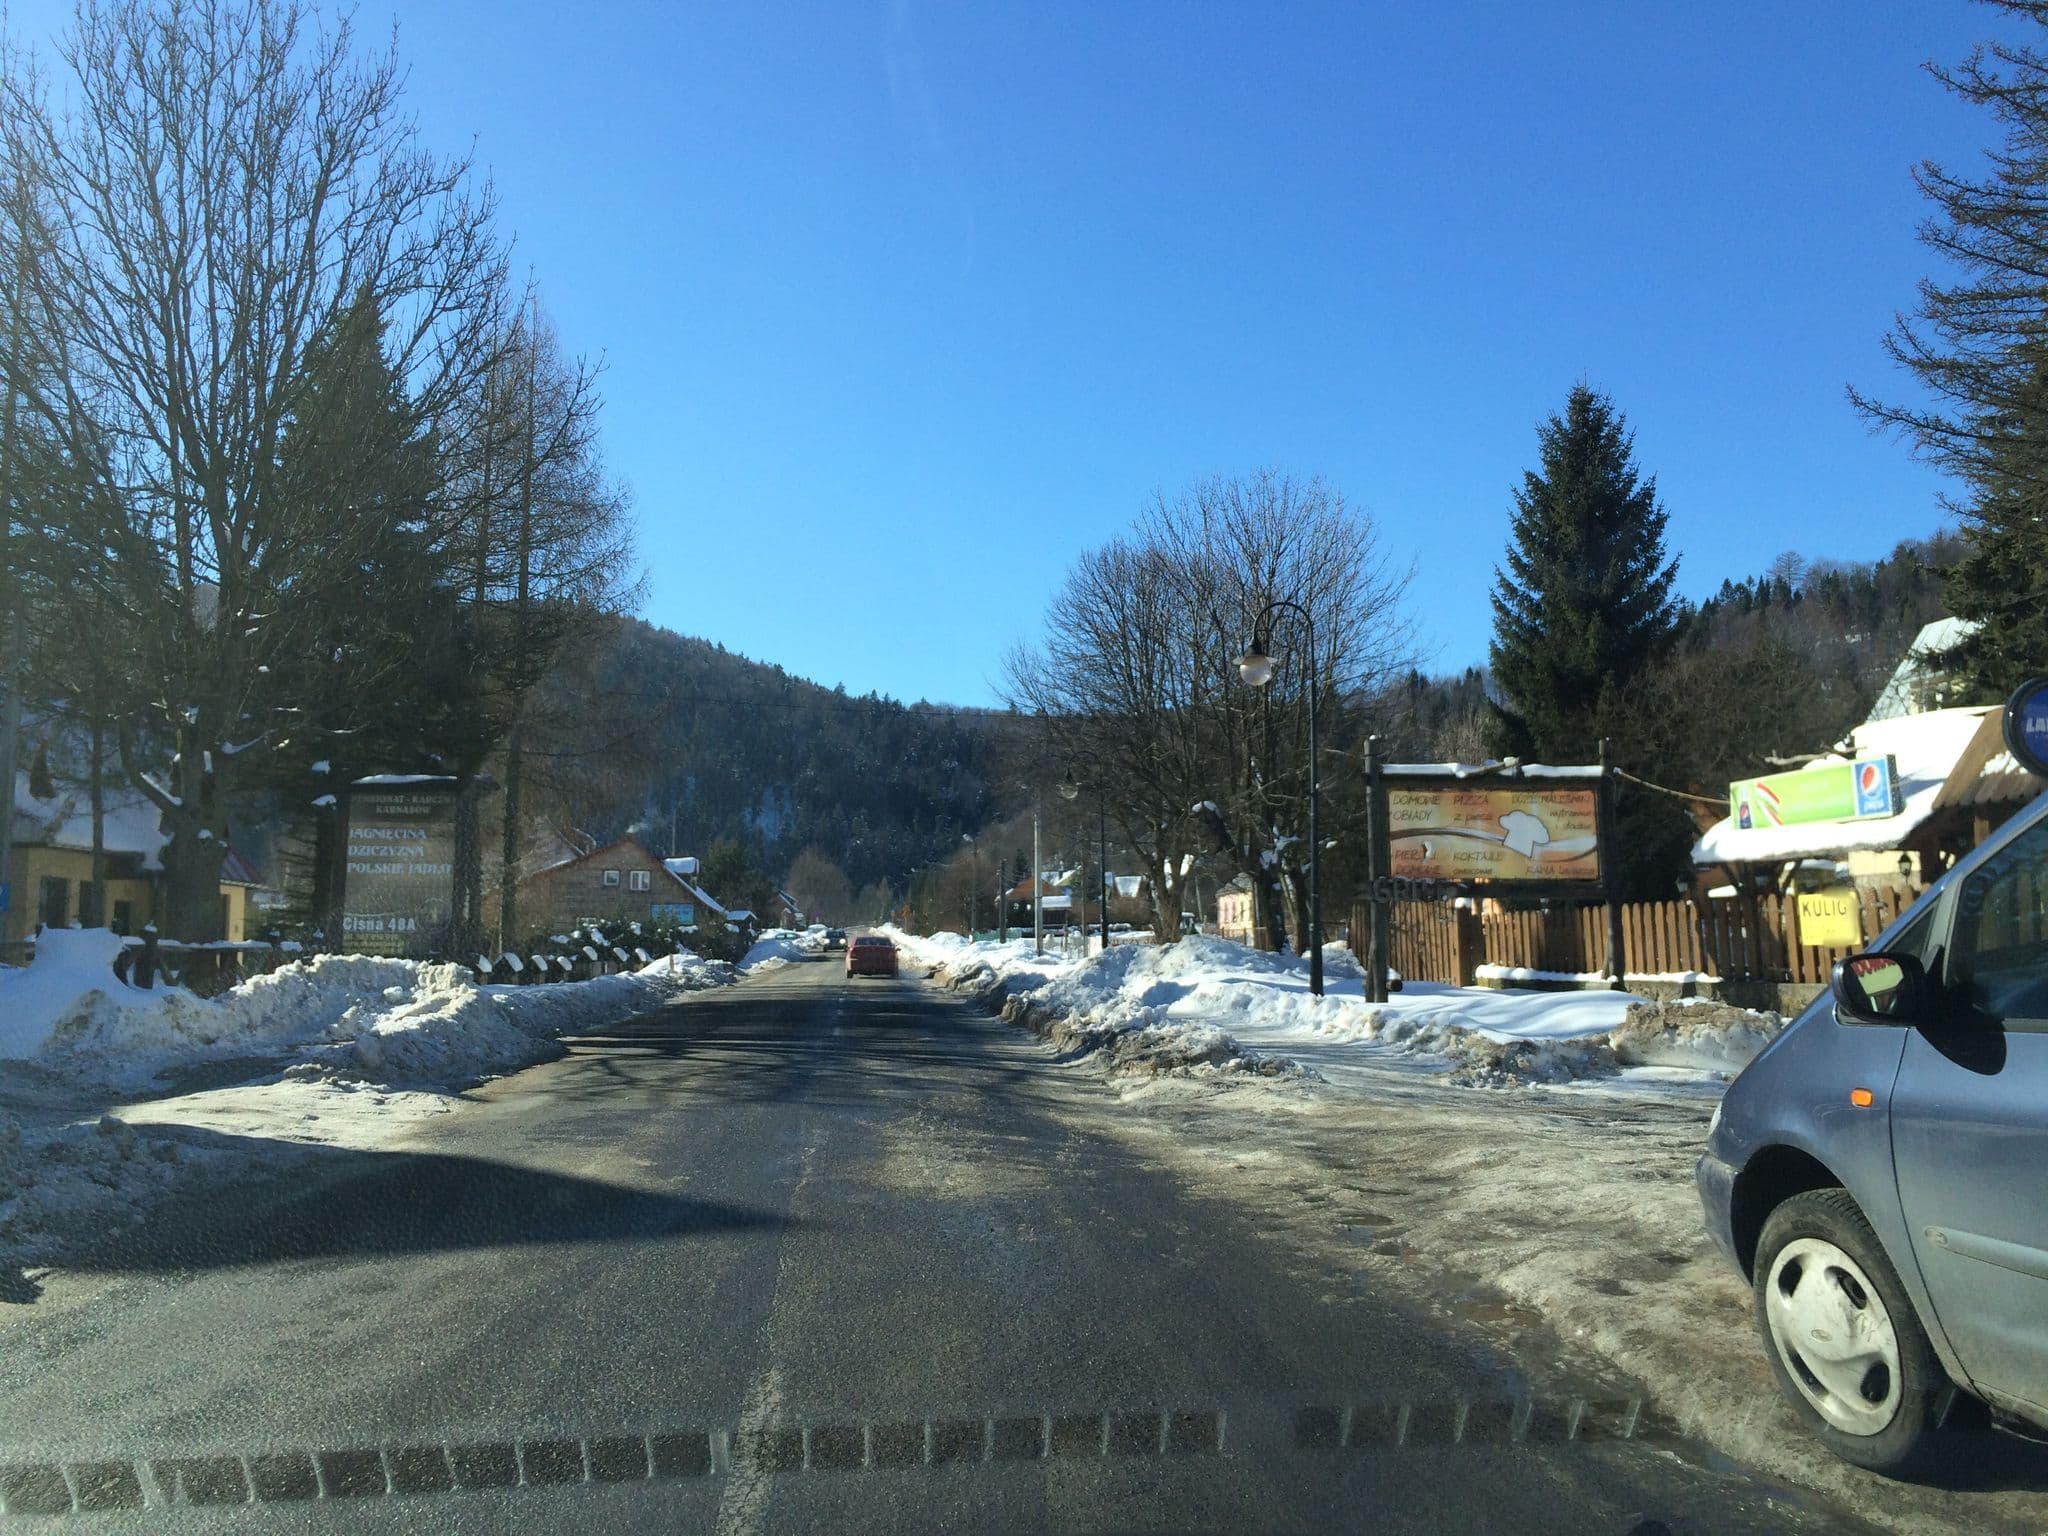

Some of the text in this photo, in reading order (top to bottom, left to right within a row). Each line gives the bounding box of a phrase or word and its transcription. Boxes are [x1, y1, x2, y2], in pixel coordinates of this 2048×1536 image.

[2026, 717, 2048, 733] LA
[1393, 809, 1432, 821] OBIADY
[1802, 900, 1847, 917] KULIG
[342, 917, 385, 931] Cisna
